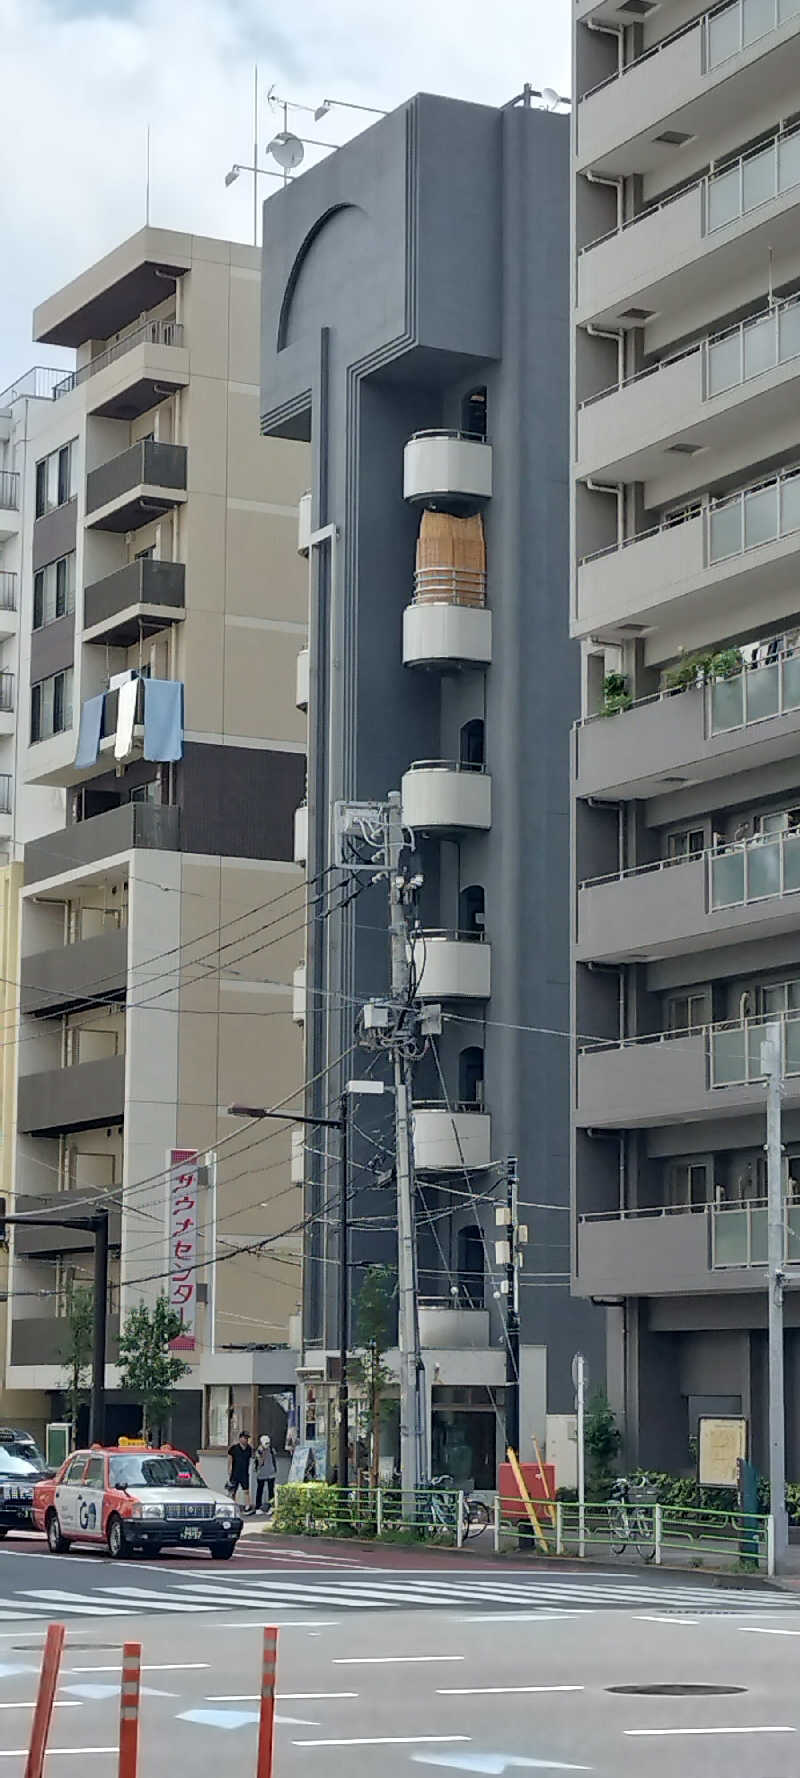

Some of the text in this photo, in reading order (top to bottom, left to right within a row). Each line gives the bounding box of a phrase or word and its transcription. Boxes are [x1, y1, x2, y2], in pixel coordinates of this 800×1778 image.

[172, 1174, 195, 1322] サウナセンター
